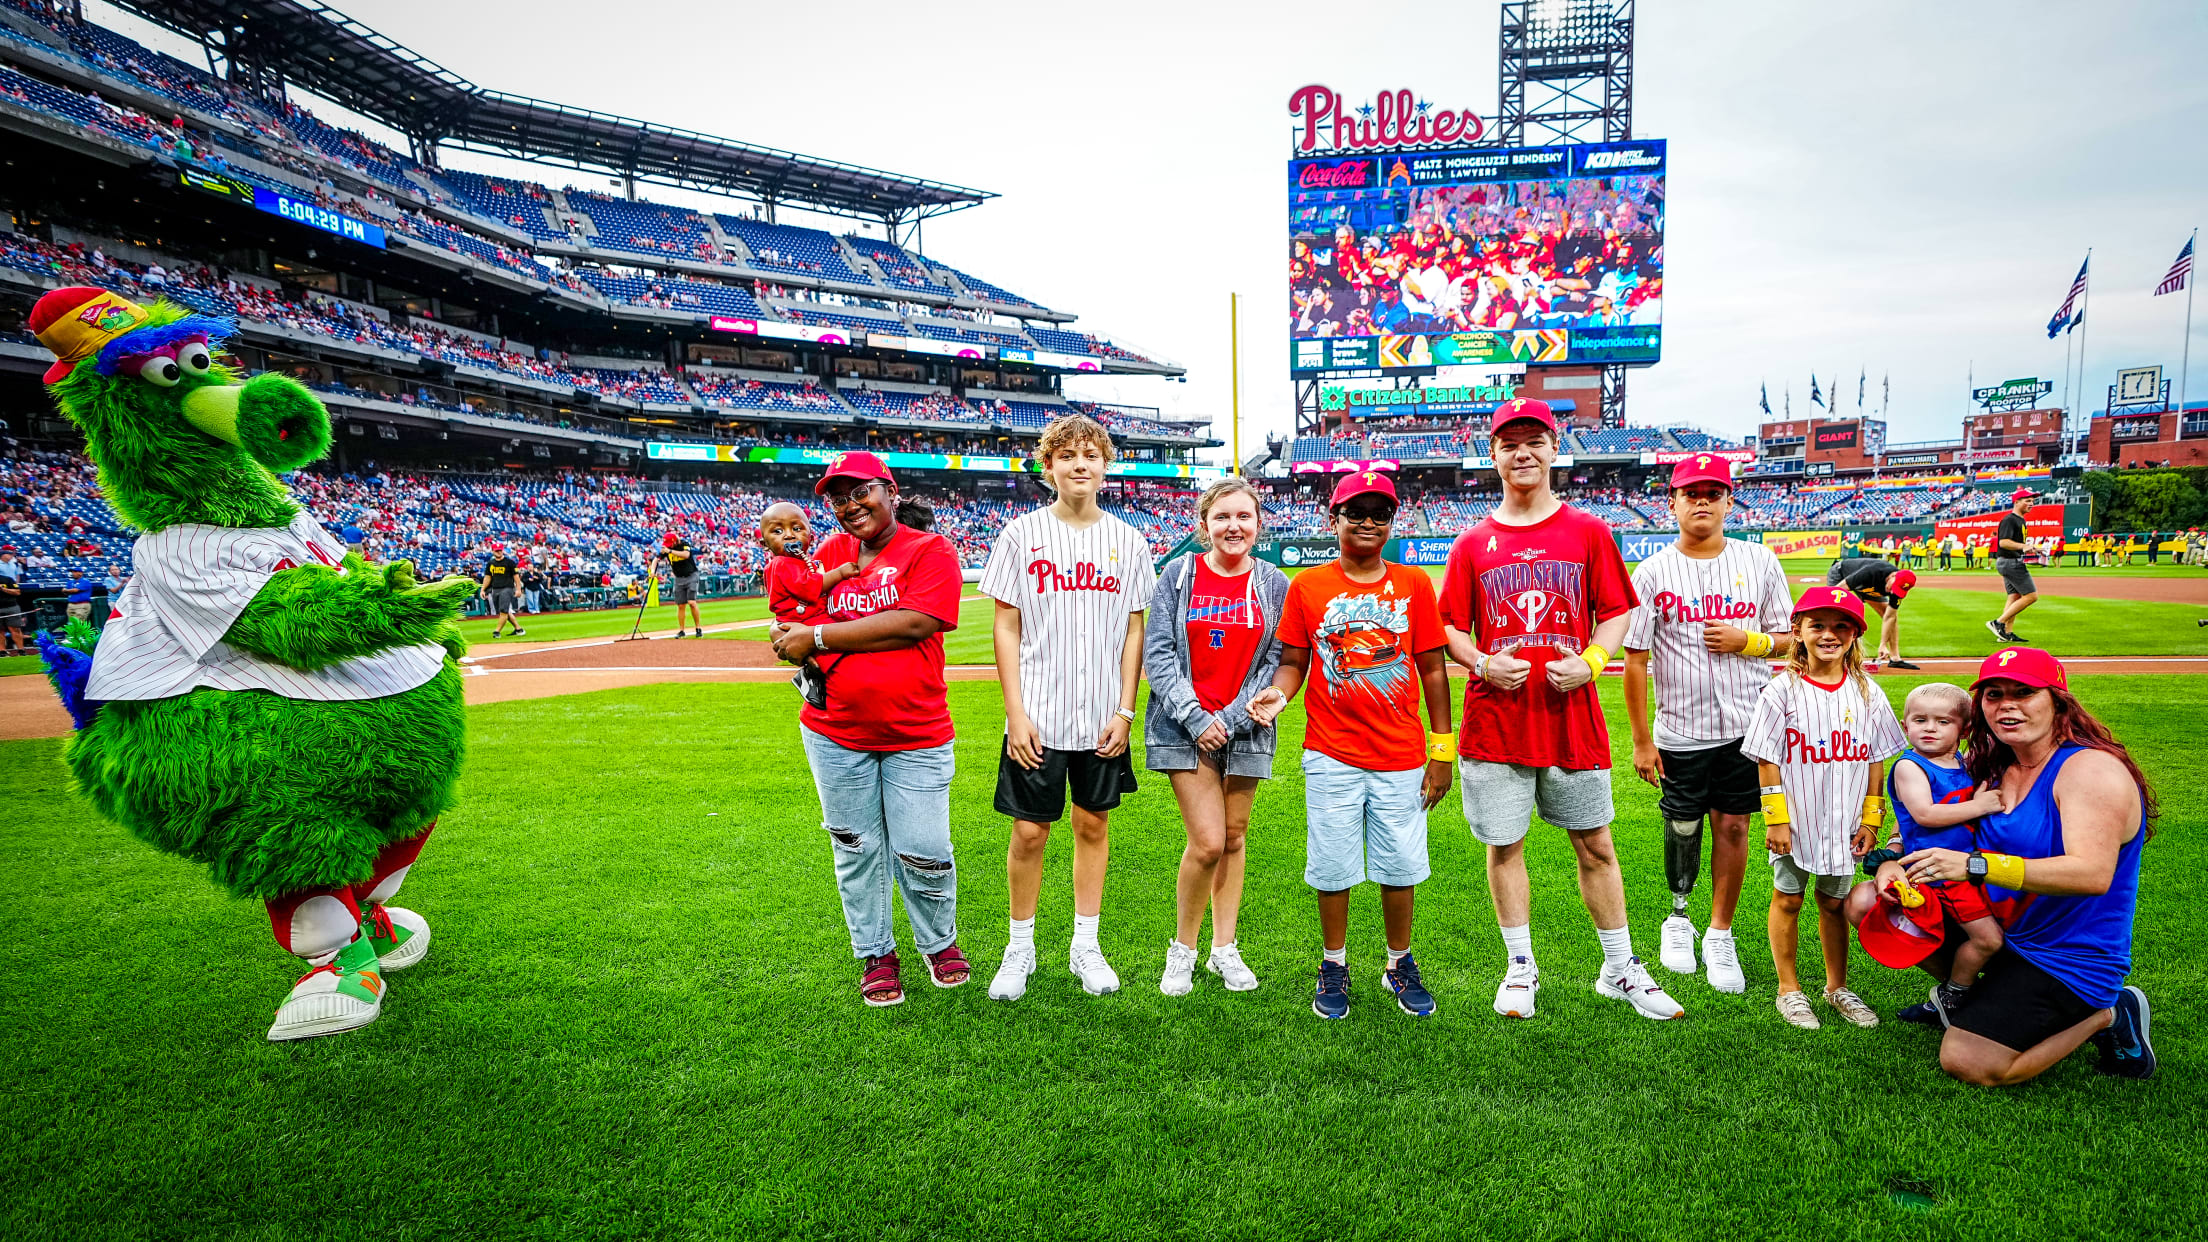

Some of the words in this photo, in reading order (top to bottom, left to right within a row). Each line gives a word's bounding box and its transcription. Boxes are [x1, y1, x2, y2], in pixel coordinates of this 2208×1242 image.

[1289, 84, 1485, 151] Phillies
[1413, 159, 1442, 170] SALTZ
[1446, 155, 1509, 168] MONGELUZZI
[1512, 153, 1563, 164] BENDESKY
[1414, 171, 1443, 180] TRIAL
[1451, 168, 1497, 178] LAWYERS
[278, 197, 339, 231] 6:04:29
[344, 220, 365, 241] PM
[1451, 332, 1494, 340] CHILDHOOD
[1571, 336, 1645, 350] Independence
[1349, 388, 1423, 406] Citizens
[1425, 385, 1471, 403] Bank
[1474, 382, 1516, 401] Park
[1978, 388, 1996, 397] CP
[1997, 382, 2046, 396] RANKIN
[1989, 397, 2033, 406] ROOFTOP
[1818, 432, 1854, 442] GIANT
[803, 449, 840, 458] CHILDHO
[1301, 547, 1341, 558] NovaCa
[1420, 541, 1452, 551] SHERW
[1419, 552, 1449, 562] WILLIA
[1028, 559, 1120, 594] Phillies
[1480, 562, 1531, 625] WORLD
[1533, 560, 1584, 619] SERIES
[1517, 590, 1547, 633] P
[1654, 591, 1756, 623] Phillies
[1495, 615, 1508, 628] 20
[1555, 611, 1567, 624] 22
[1998, 650, 2017, 666] P
[1786, 727, 1870, 764] Phillie
